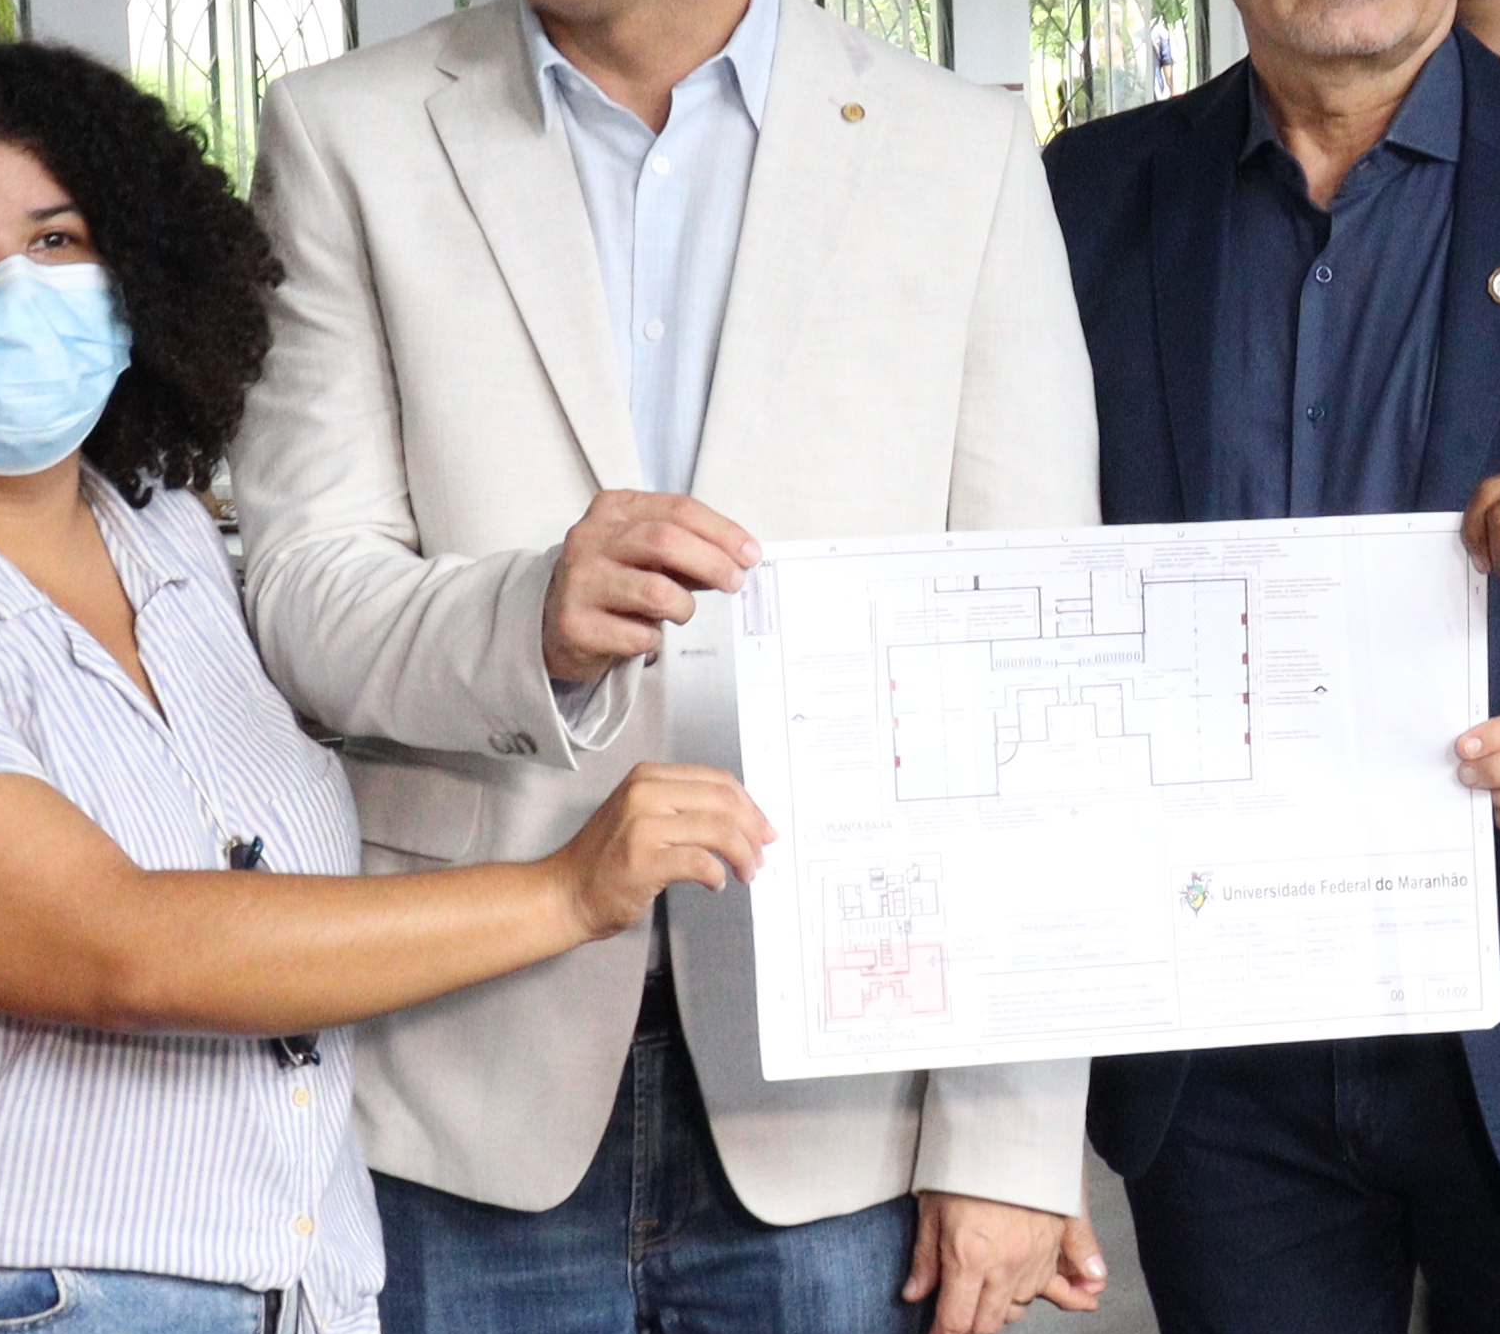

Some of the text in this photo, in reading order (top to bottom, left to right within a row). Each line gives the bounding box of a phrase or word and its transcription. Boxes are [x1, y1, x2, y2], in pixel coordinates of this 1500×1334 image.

[1222, 872, 1469, 902] Universidade Federal do Maranhão
[1390, 988, 1405, 1002] 00
[1437, 985, 1468, 1000] 01/02
